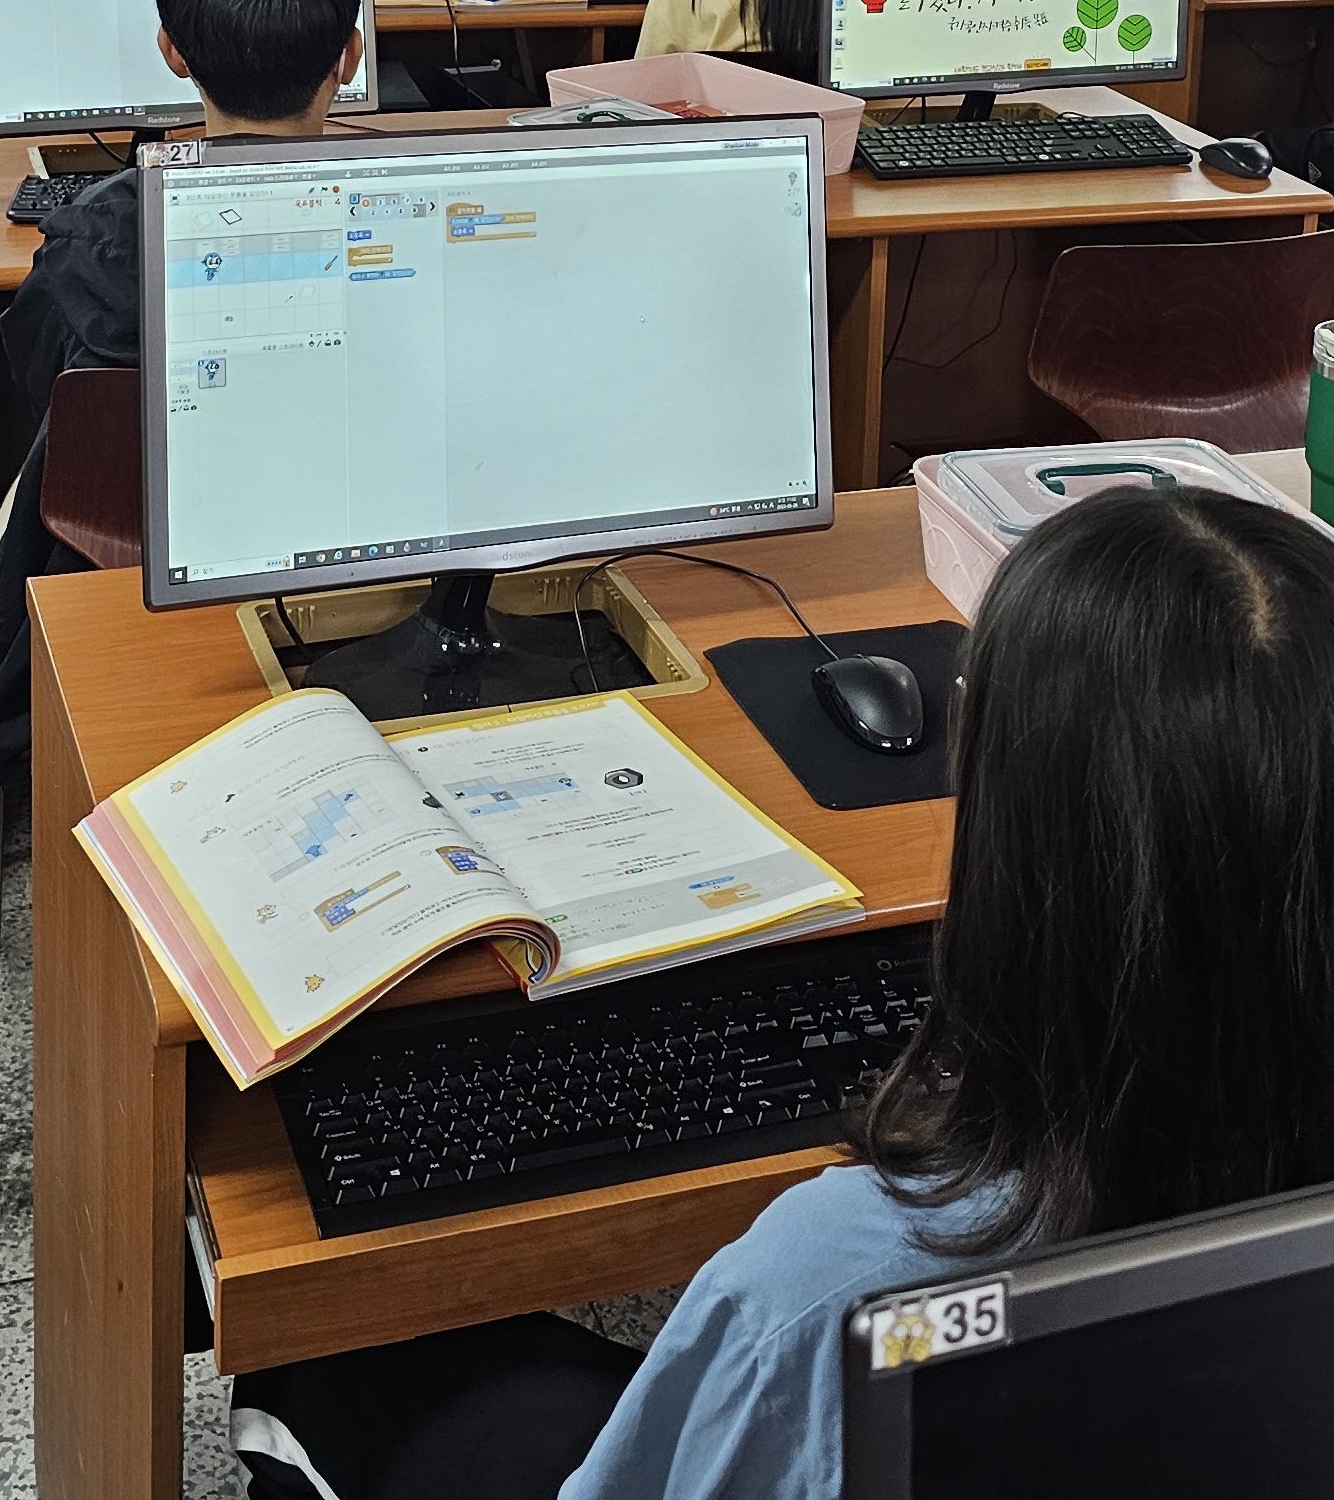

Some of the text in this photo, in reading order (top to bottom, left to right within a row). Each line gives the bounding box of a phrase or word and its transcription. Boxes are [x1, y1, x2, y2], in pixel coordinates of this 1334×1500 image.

[148, 116, 181, 124] Redstone
[170, 144, 194, 161] 27
[943, 1293, 997, 1343] 35
